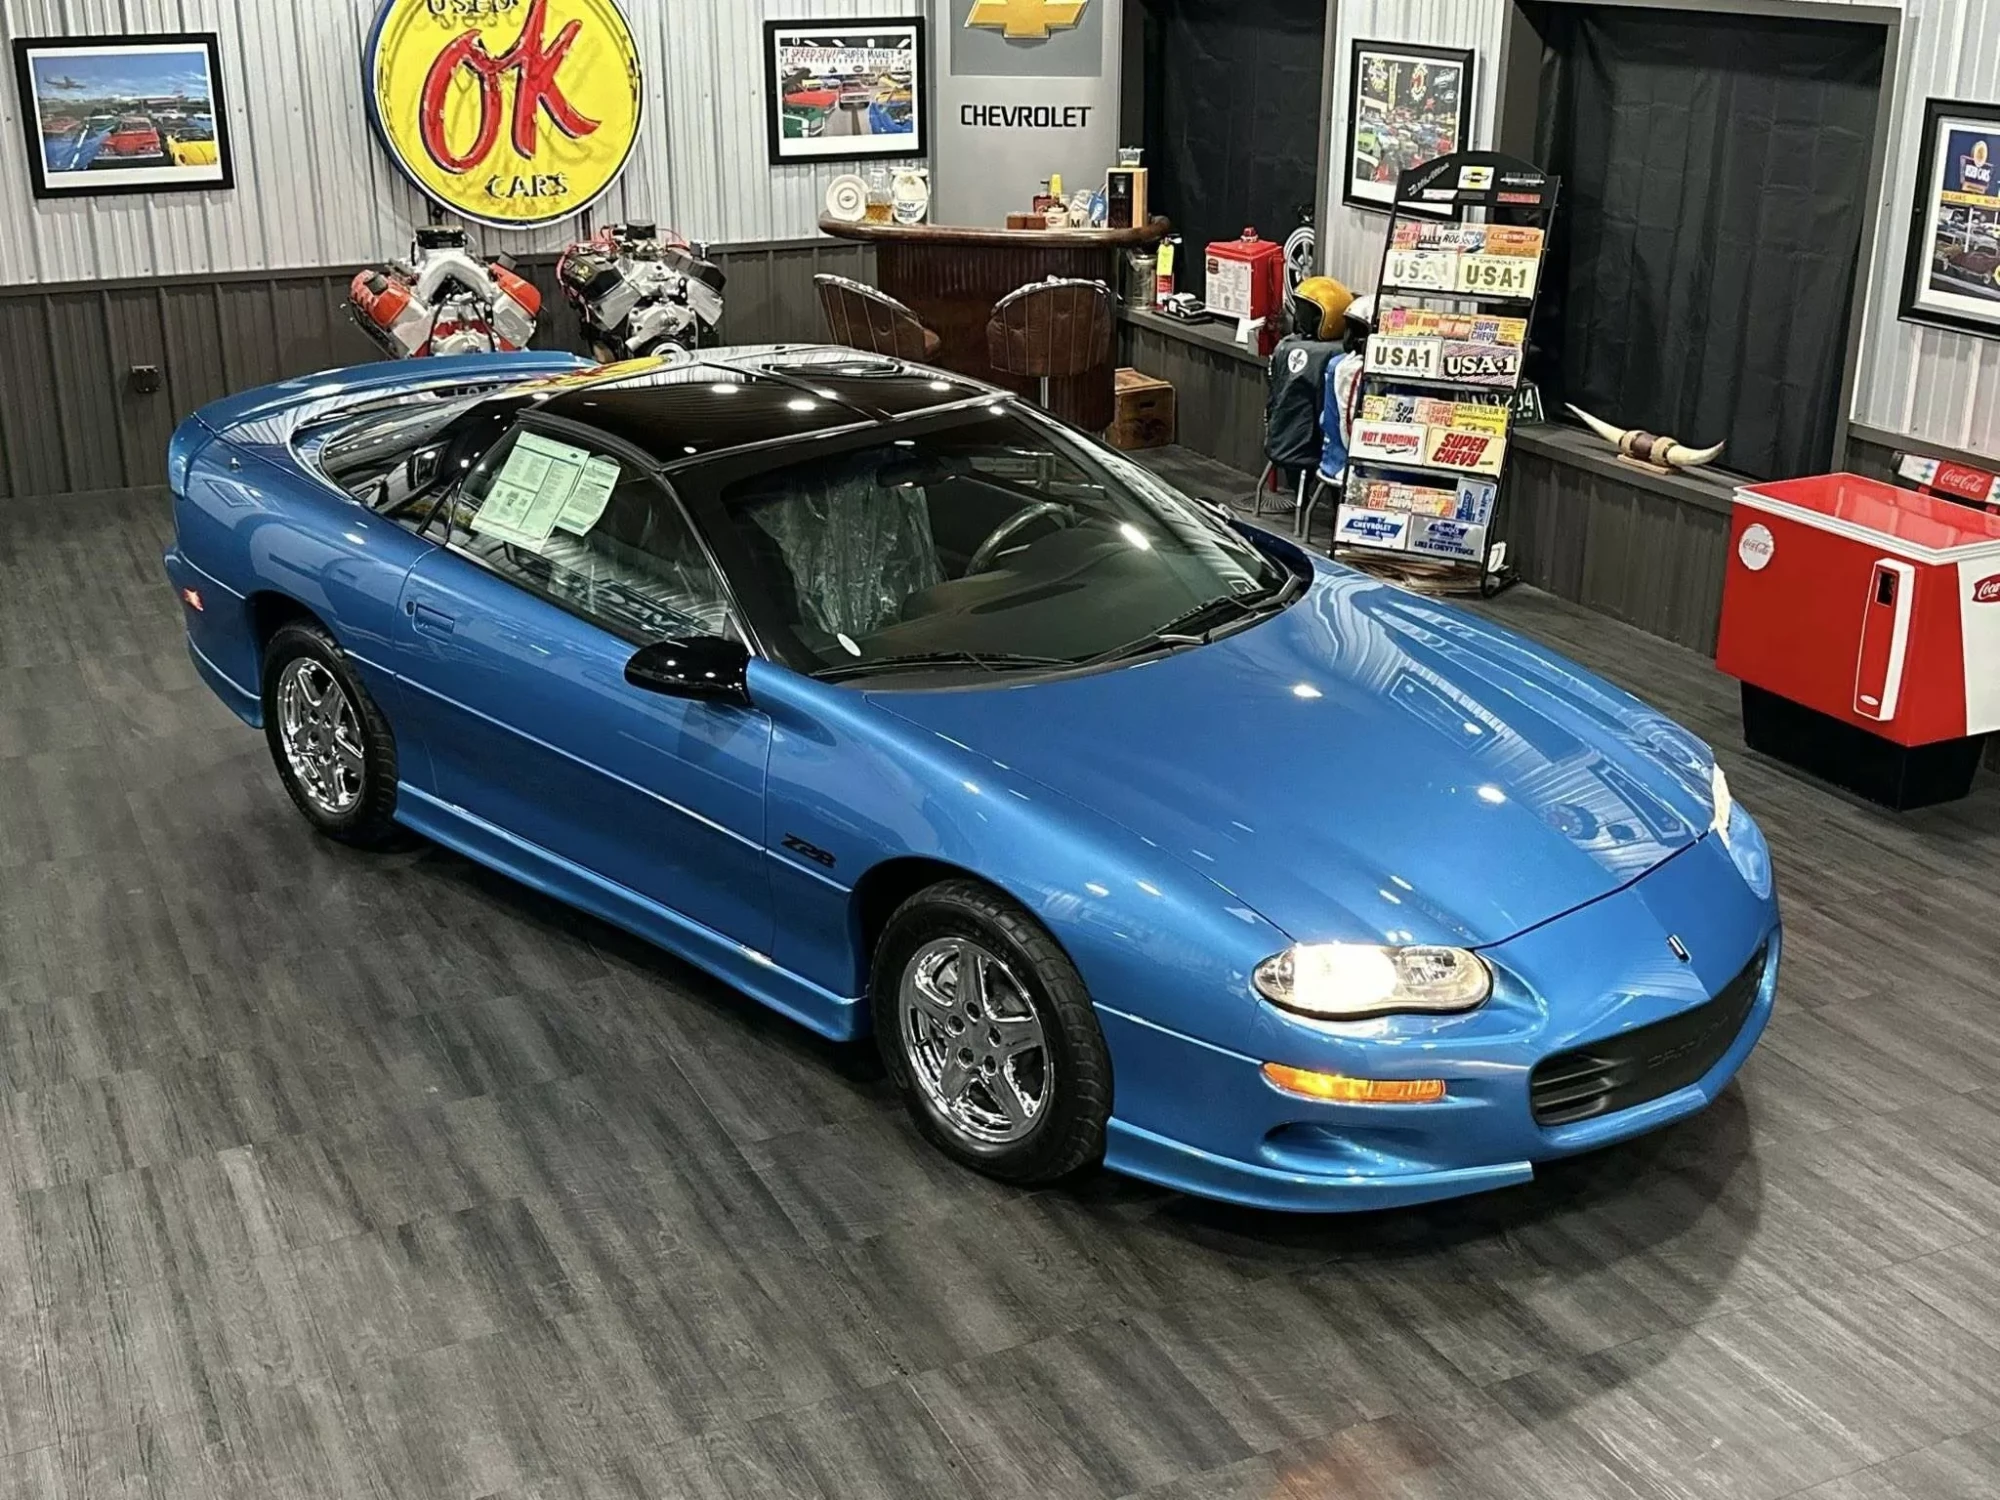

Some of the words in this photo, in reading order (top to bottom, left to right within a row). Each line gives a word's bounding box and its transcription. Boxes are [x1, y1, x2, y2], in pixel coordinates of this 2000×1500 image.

[791, 48, 817, 58] SPEED
[868, 50, 894, 59] MARKET
[419, 0, 602, 175] OK
[960, 104, 1092, 127] CHEVROLET
[485, 173, 568, 198] CARS
[1473, 321, 1499, 332] SUPER
[1471, 331, 1498, 343] CHEVY
[1455, 404, 1499, 415] CHRYSLER
[1361, 431, 1379, 443] HOT
[1380, 433, 1420, 447] RODDING
[1440, 432, 1489, 454] SUPER
[1432, 447, 1482, 467] CHEVY
[1353, 520, 1392, 531] CHEVROLET
[1434, 543, 1454, 553] CHEVY
[1455, 546, 1475, 556] TRUCK
[781, 832, 836, 869] Z28
